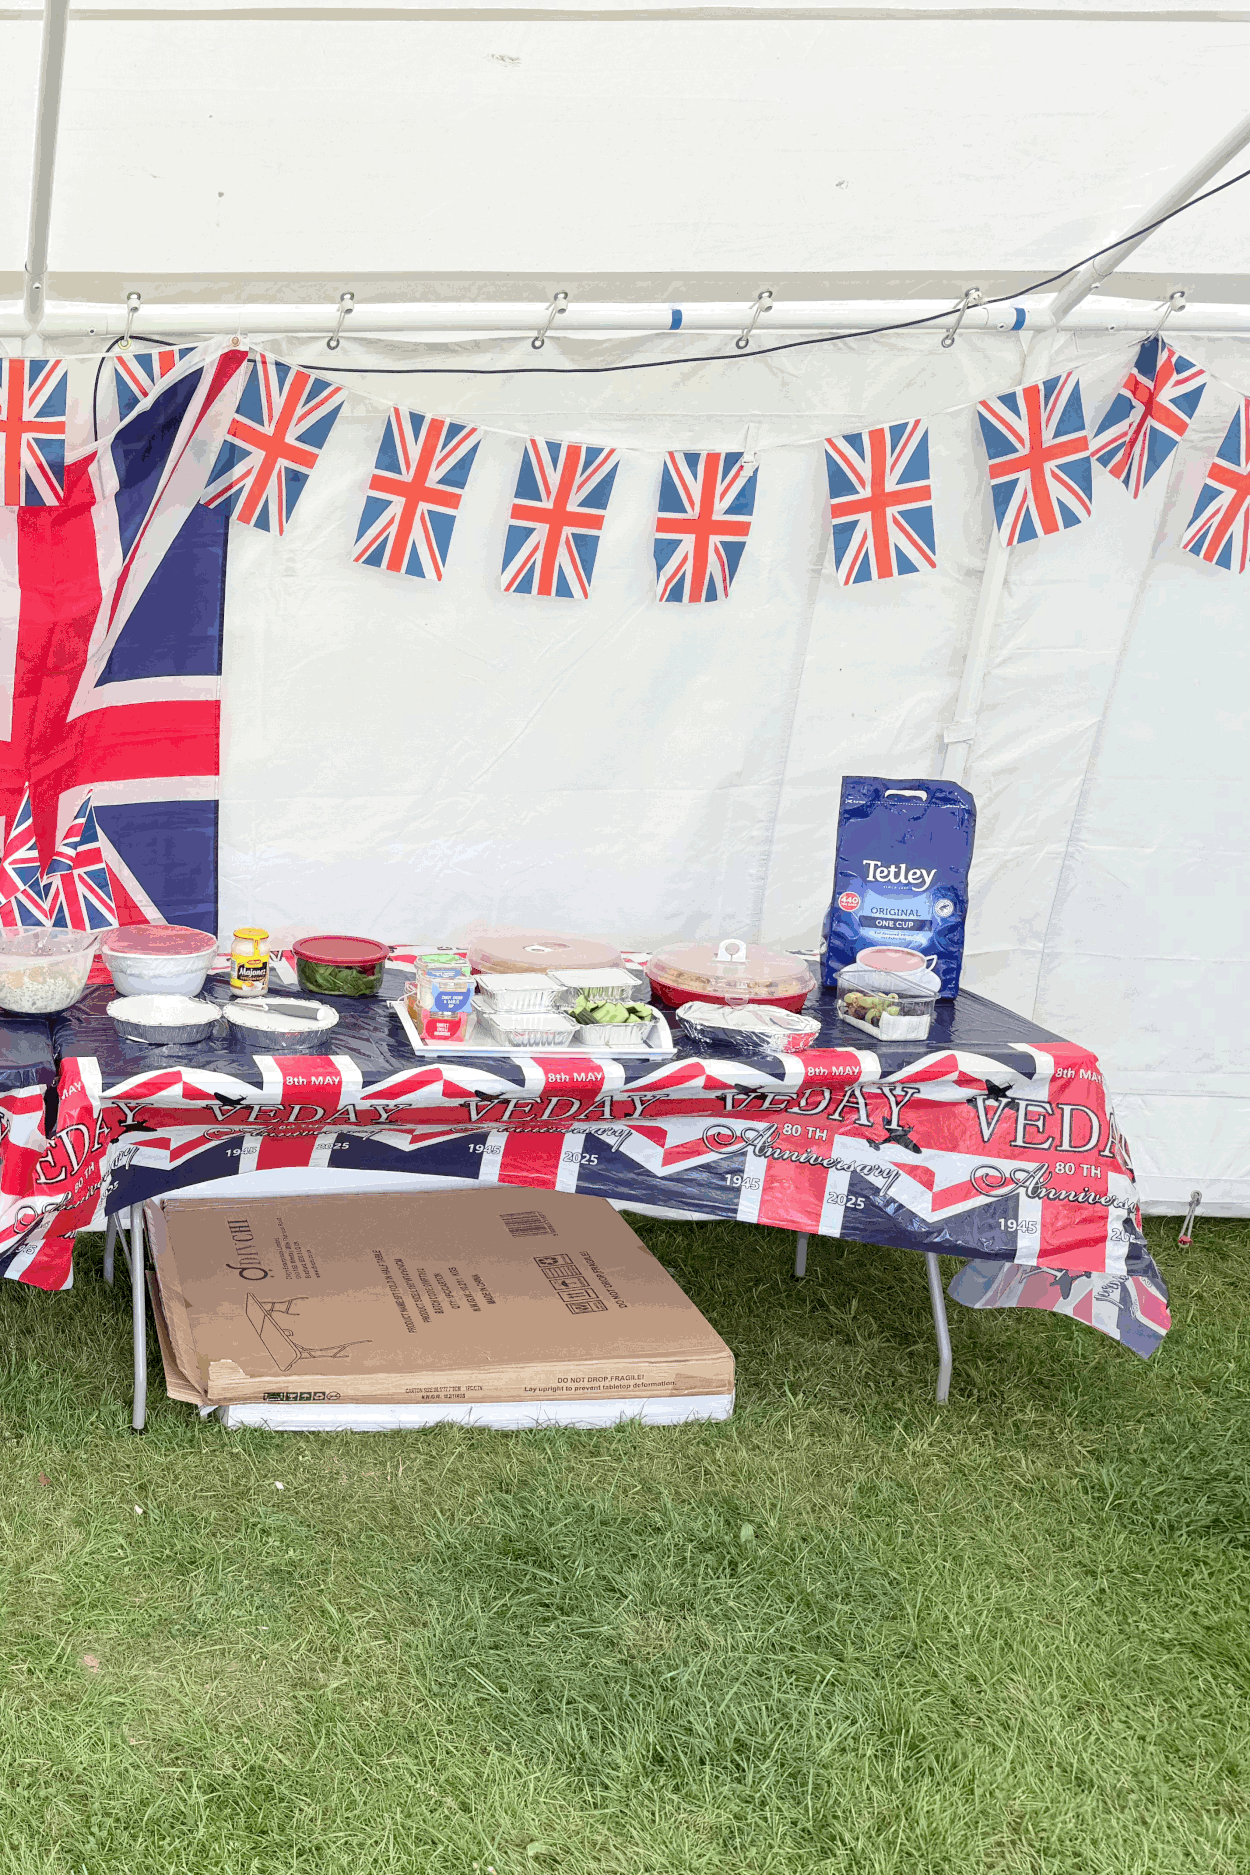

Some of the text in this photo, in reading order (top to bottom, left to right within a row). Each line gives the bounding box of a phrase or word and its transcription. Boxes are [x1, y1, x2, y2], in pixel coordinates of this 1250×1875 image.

[863, 860, 937, 892] Tetley
[840, 896, 859, 904] 440
[870, 906, 921, 917] ORIGINAL
[876, 919, 894, 928] ONE
[547, 1072, 603, 1083] 8th MAY
[807, 1066, 860, 1077] 8th MAY
[1055, 1067, 1075, 1078] 8th
[286, 1076, 340, 1086] 8th MAY
[203, 1103, 412, 1124] VEDAY
[461, 1093, 670, 1123] VEDAY
[717, 1085, 922, 1130] VEDAY
[783, 1123, 828, 1141] 80 TH
[973, 1095, 1135, 1170] VEDA
[36, 1101, 154, 1184] EDAY
[225, 1147, 258, 1158] 1945
[467, 1143, 599, 1165] 1945 2025
[702, 1122, 901, 1197] Anniversary
[1054, 1162, 1102, 1179] 80 TH
[724, 1173, 866, 1210] 1945 2025
[998, 1217, 1038, 1235] 1945
[227, 1219, 262, 1267] DIVCHI
[538, 1384, 564, 1393] upright
[574, 1384, 601, 1392] prevent
[602, 1383, 631, 1391] tabletop
[632, 1380, 678, 1389] deformation.
[557, 1376, 568, 1384] DO
[570, 1376, 586, 1384] NOT
